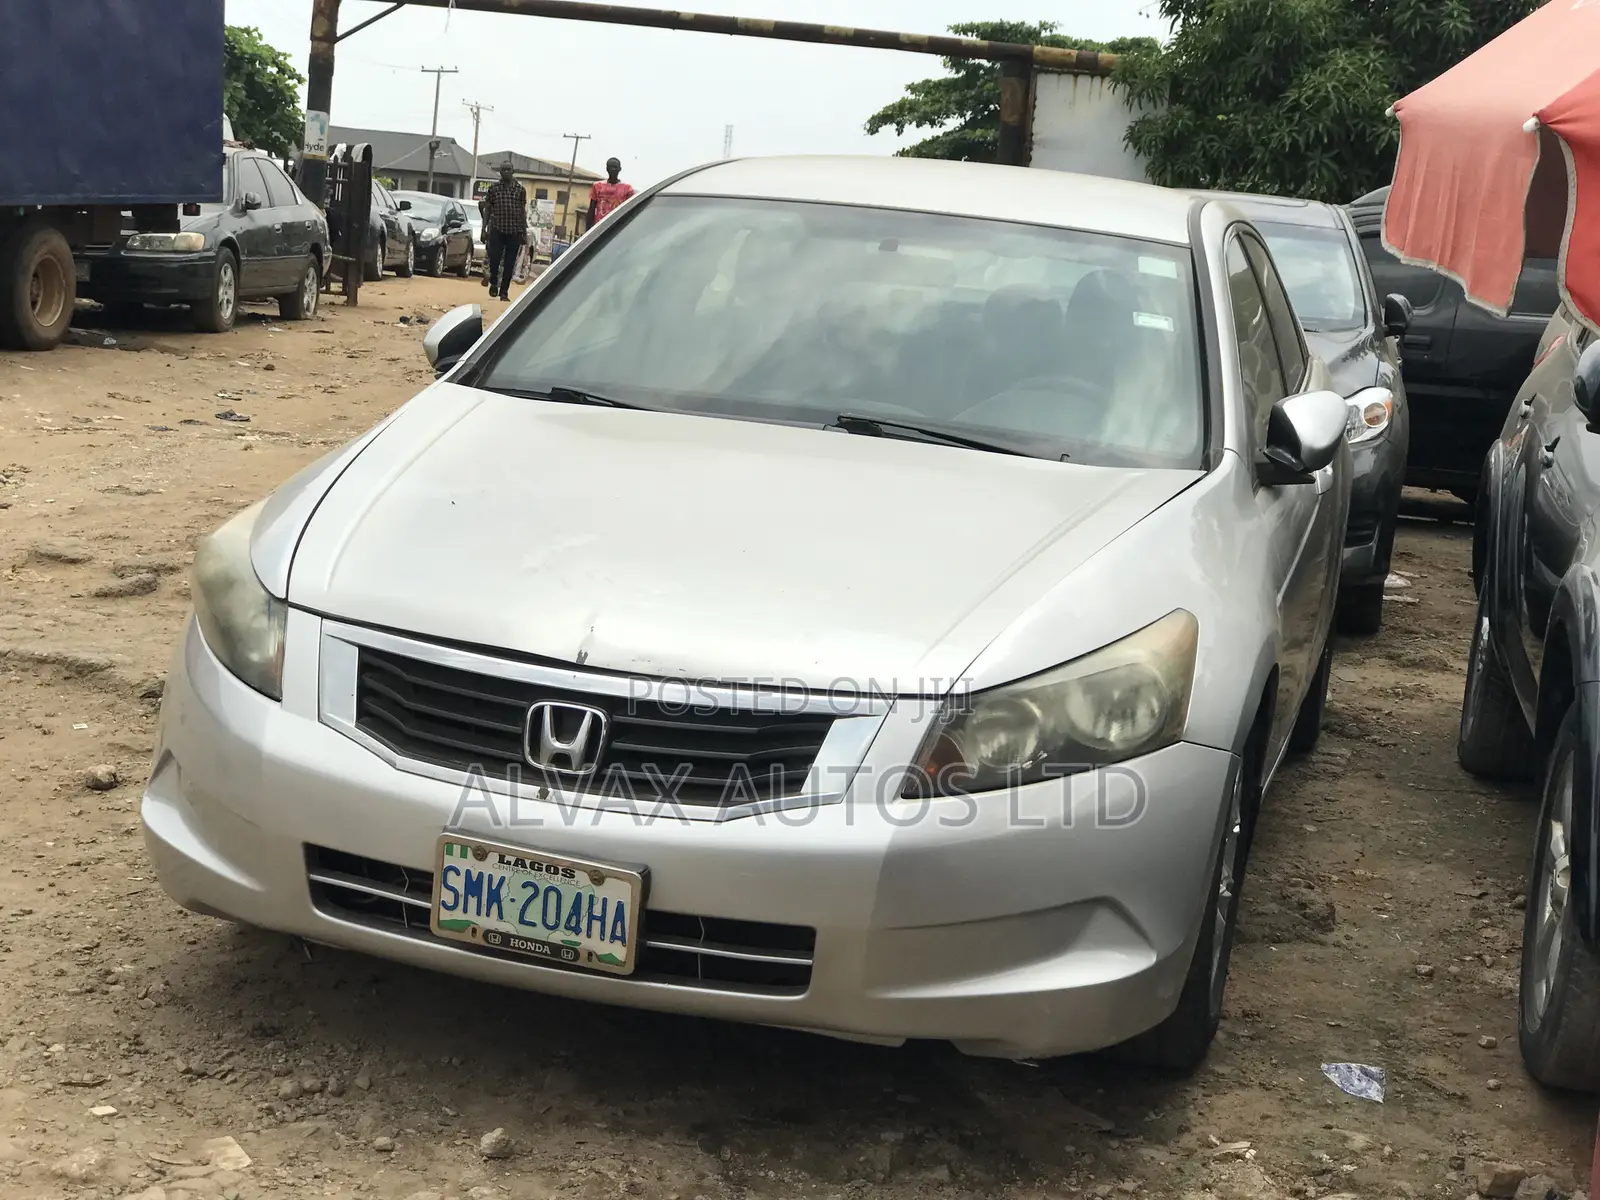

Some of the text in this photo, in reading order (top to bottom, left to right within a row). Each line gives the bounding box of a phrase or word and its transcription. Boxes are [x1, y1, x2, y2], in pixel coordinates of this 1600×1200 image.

[492, 863, 521, 874] CENTRE
[534, 871, 580, 887] EXCELLENCE
[498, 854, 576, 879] LAGOS
[510, 937, 551, 955] HONDA
